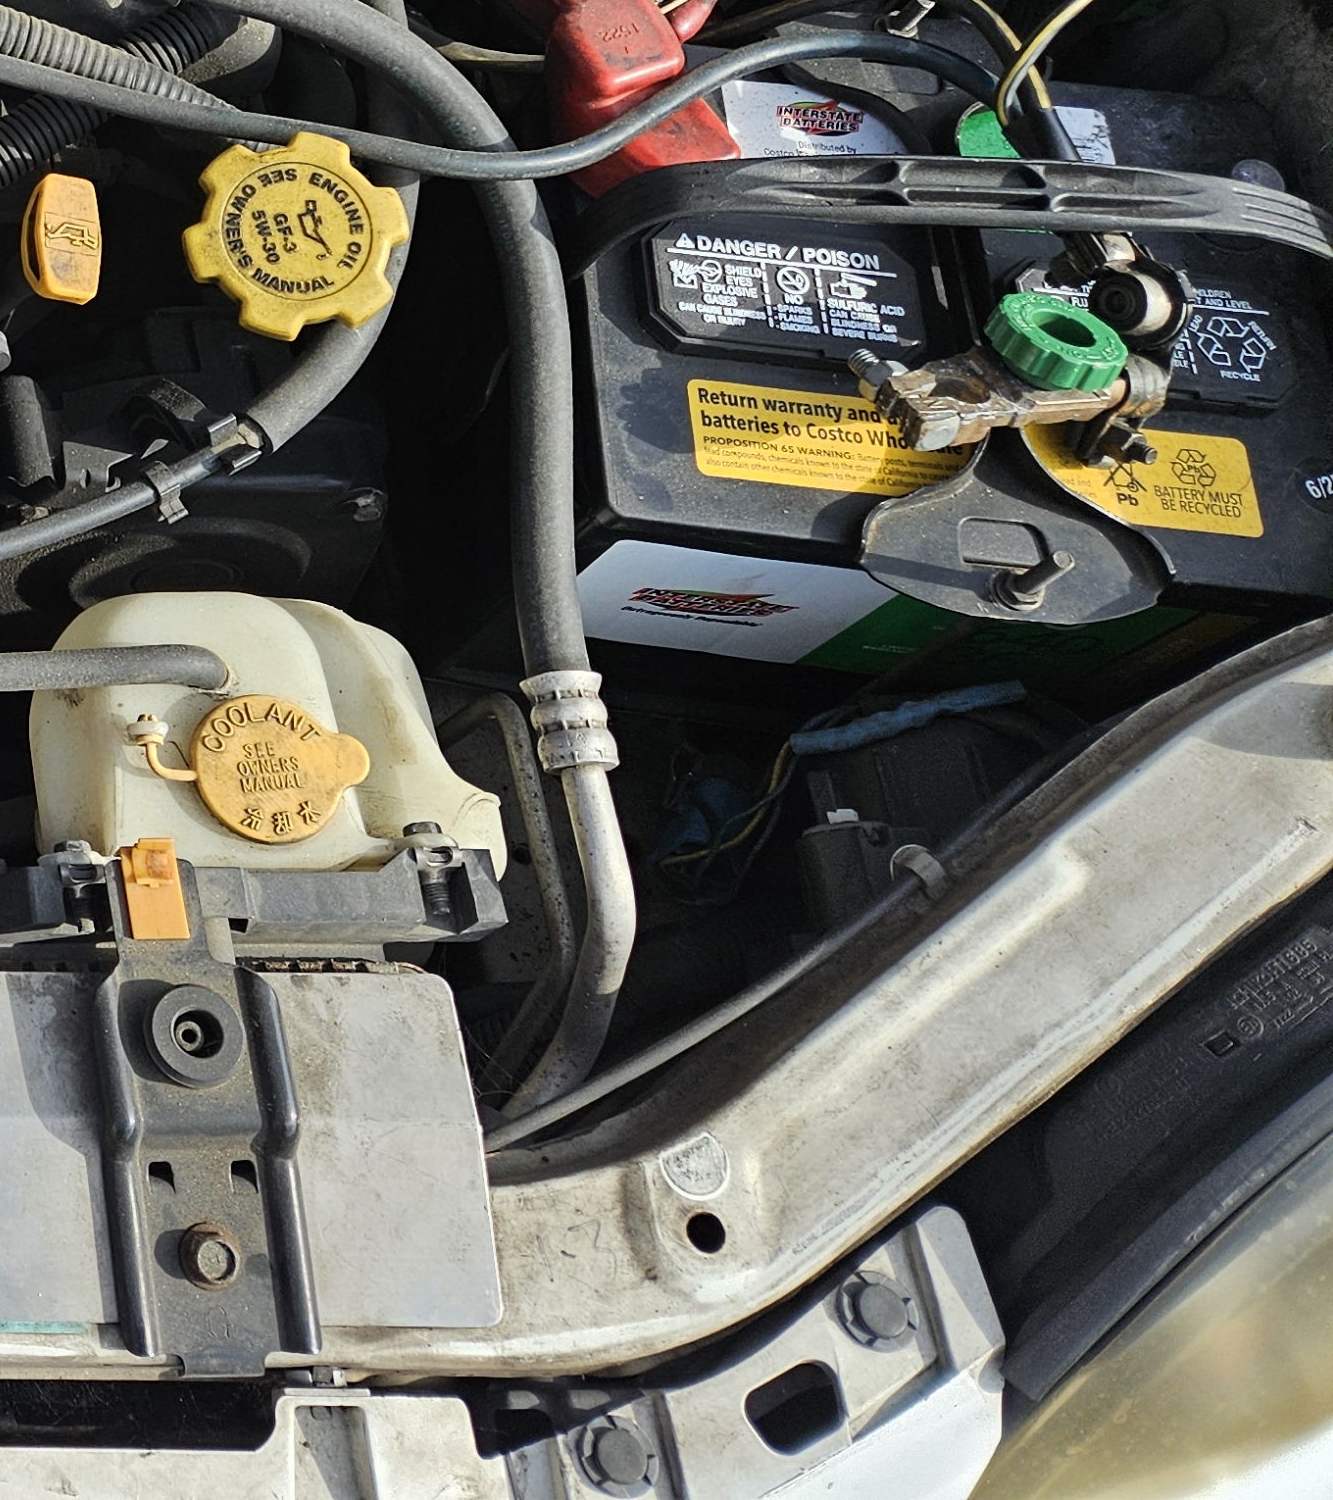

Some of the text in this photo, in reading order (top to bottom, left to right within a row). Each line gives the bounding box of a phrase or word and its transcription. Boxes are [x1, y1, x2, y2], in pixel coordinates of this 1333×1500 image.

[778, 107, 861, 122] INTERSTATE
[783, 118, 858, 131] BATTERIES
[798, 140, 845, 153] Distributed
[846, 145, 857, 155] by
[308, 171, 364, 270] ENGINE OIL
[225, 168, 335, 294] SEE OWNER'S MANUAL
[251, 210, 281, 264] 5W-30
[273, 212, 299, 254] GF-3
[696, 235, 782, 259] DANGER
[803, 247, 880, 271] POISON
[724, 264, 762, 278] SHIELD
[725, 275, 754, 287] EYES
[702, 283, 759, 299] EXPLOSIVE
[703, 293, 738, 308] GASES
[784, 294, 805, 306] NO
[679, 302, 767, 321] CAN CAUSE BLINDNESS
[827, 298, 906, 317] SULFURIC ACID
[1205, 297, 1253, 310] AND LEVEL
[703, 314, 716, 323] OR
[828, 309, 881, 323] CAN CAUSE
[1189, 315, 1203, 333] LEAD
[831, 319, 897, 334] BLINDNESS OR
[832, 327, 899, 344] SEVERE BURNS
[1247, 320, 1276, 351] RETURN
[1219, 370, 1261, 383] RECYCLE
[698, 387, 758, 410] Return
[762, 395, 843, 424] warranty
[847, 405, 881, 424] and
[701, 410, 863, 445] batteries to Costco
[703, 435, 779, 453] PROPOSITION
[780, 443, 795, 454] 65
[797, 446, 856, 461] WARNING:
[706, 457, 721, 467] also
[723, 459, 747, 470] contain
[749, 461, 770, 472] other
[771, 463, 806, 476] chemicals
[808, 468, 832, 479] known
[834, 471, 842, 481] to
[843, 472, 857, 482] the
[768, 452, 804, 466] chemicals
[806, 457, 830, 468] known
[832, 460, 840, 469] to
[841, 461, 854, 471] the
[1187, 464, 1201, 474] Pb
[1116, 492, 1139, 507] Pb
[1154, 485, 1244, 507] BATTERY MUST
[1161, 499, 1242, 518] BE RECYCLED
[202, 702, 322, 752] COOLANT
[243, 742, 276, 759] SEE
[237, 756, 300, 777] OWNERS
[239, 773, 306, 793] MANUAL
[240, 800, 322, 835] 冷却水
